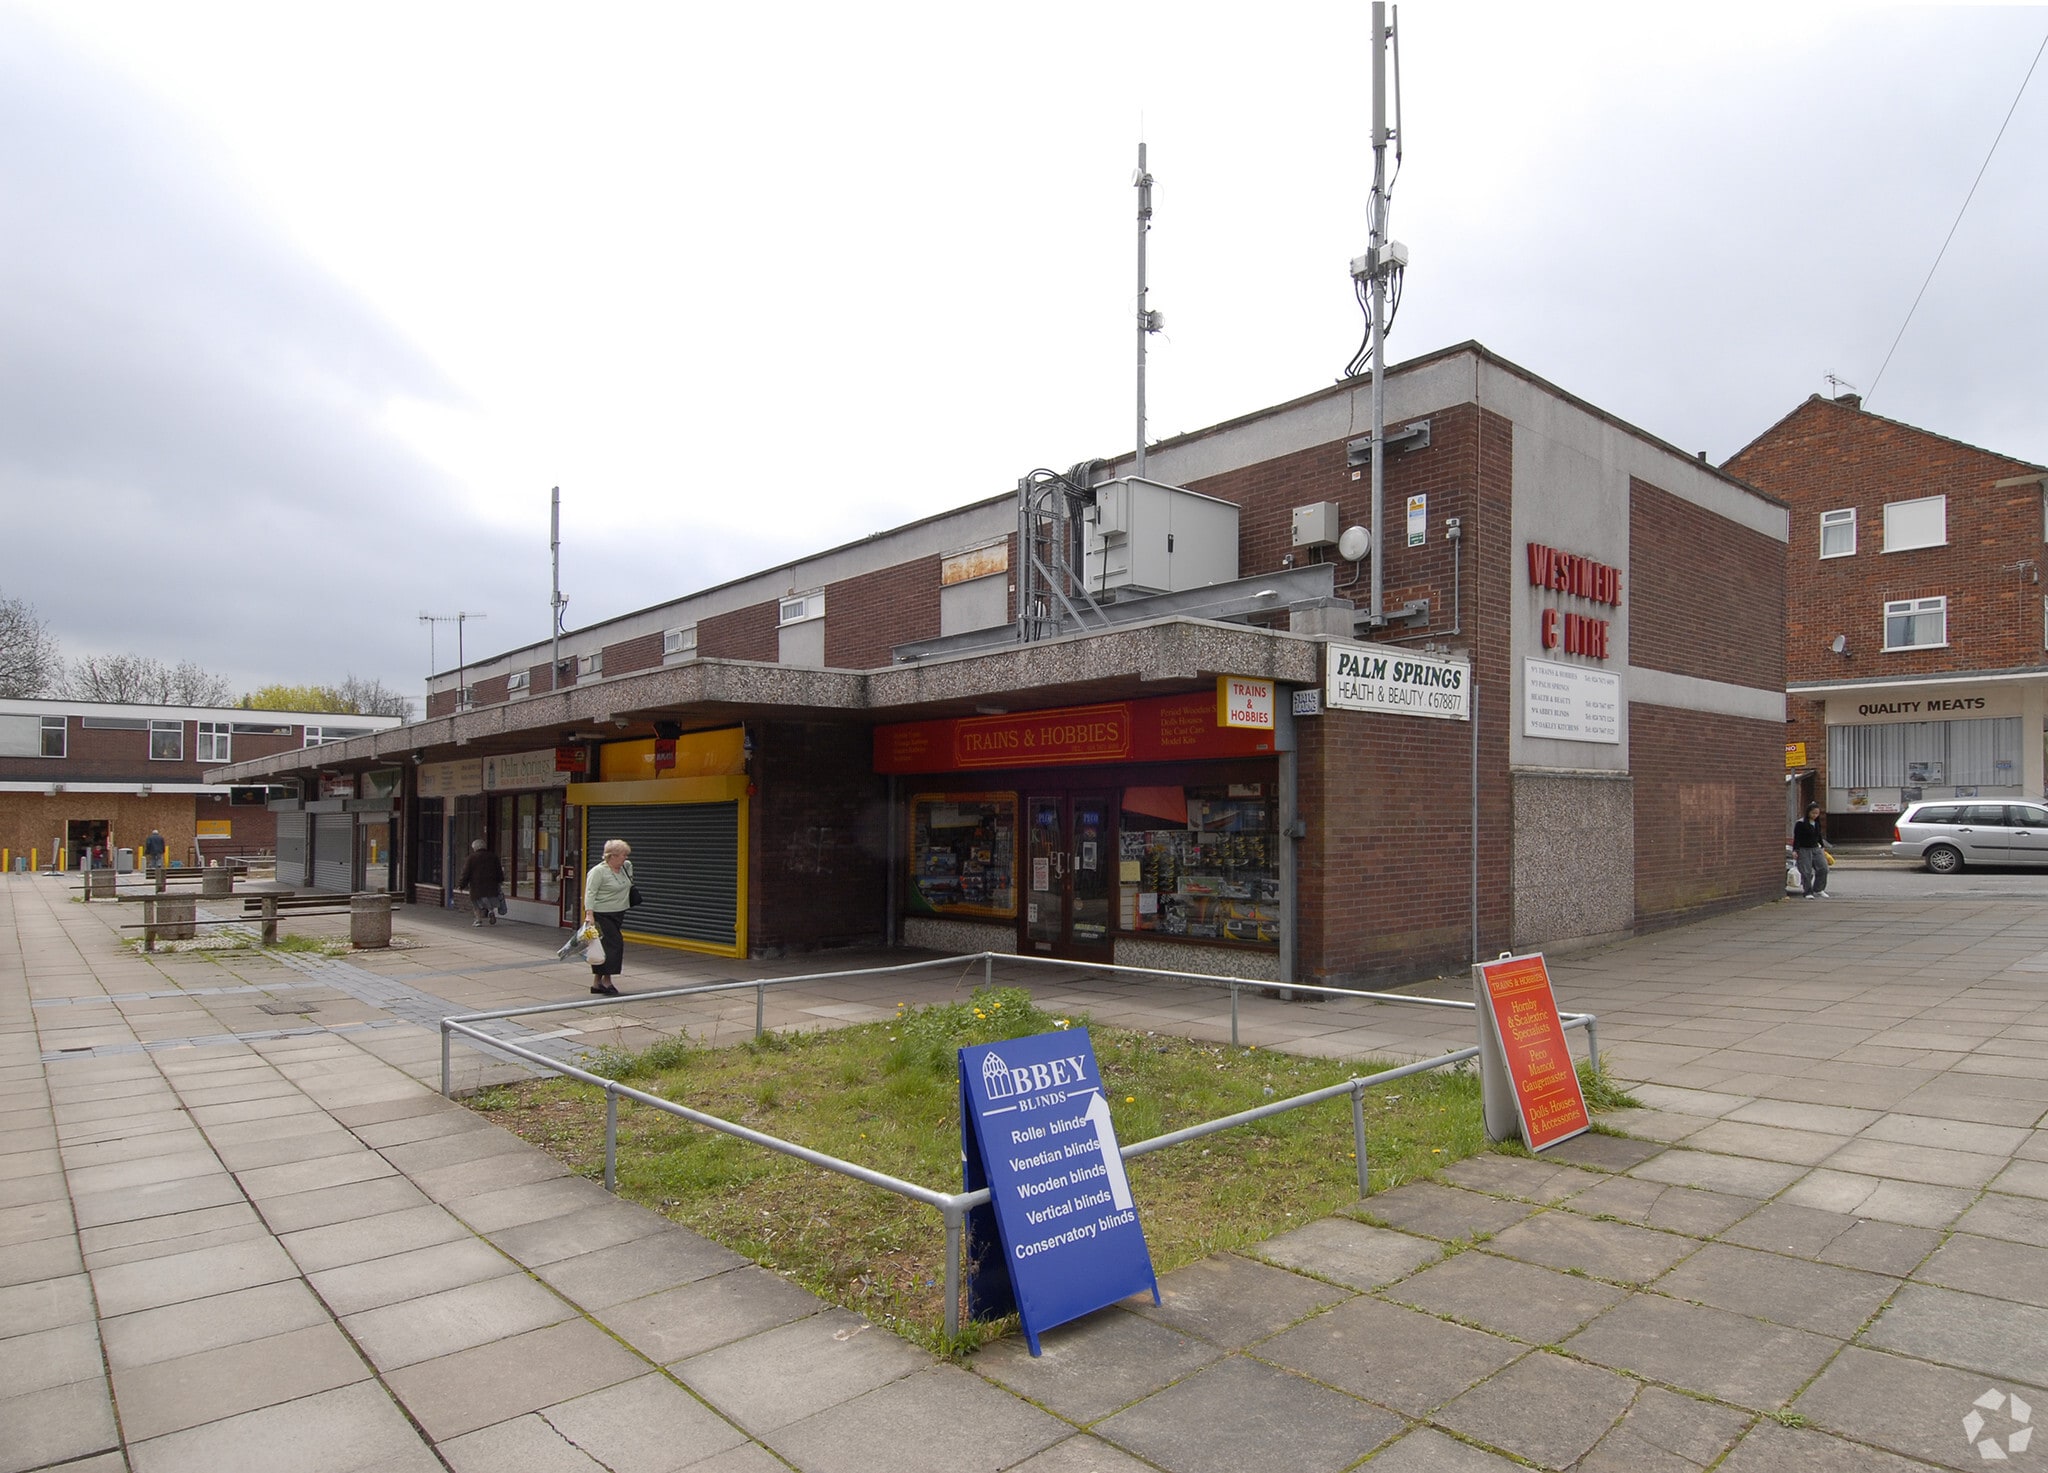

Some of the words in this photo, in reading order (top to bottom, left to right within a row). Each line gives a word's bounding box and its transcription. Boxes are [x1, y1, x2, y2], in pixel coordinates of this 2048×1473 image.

[1527, 542, 1624, 607] WESTMEDE
[1337, 653, 1388, 681] PALM
[1392, 661, 1462, 690] SPRINGS
[1233, 683, 1267, 698] TRAINS
[1338, 681, 1375, 700] HEALTH
[1377, 685, 1385, 702] &
[1388, 687, 1424, 706] BEAUTY
[1246, 699, 1253, 710] &
[1858, 701, 1921, 716] QUALITY
[1927, 698, 1985, 711] MEATS
[1231, 709, 1269, 724] HOBBIES
[964, 729, 1019, 751] TRAINS
[1023, 728, 1036, 748] &
[1040, 722, 1119, 746] HOBBIES
[1492, 979, 1514, 992] TRAINS
[1511, 999, 1537, 1013] Hornby
[1507, 1016, 1515, 1028] &
[1514, 1010, 1549, 1027] Scalextric
[1512, 1023, 1551, 1041] Specialists
[1529, 1049, 1547, 1062] Peco
[1528, 1058, 1555, 1076] Mamod
[1522, 1070, 1567, 1093] Gaugemaster
[1018, 1091, 1067, 1112] BLINDS
[1529, 1104, 1550, 1121] Dolls
[1549, 1097, 1576, 1113] Houses
[1049, 1115, 1087, 1135] blinds
[1532, 1121, 1540, 1135] &
[1541, 1109, 1580, 1131] Accessories
[1009, 1149, 1062, 1172] Venetian
[1064, 1138, 1101, 1158] blinds
[1017, 1176, 1068, 1199] Wooden
[1069, 1163, 1107, 1184] blinds
[1026, 1199, 1073, 1225] Vertical
[1074, 1190, 1111, 1211] blinds
[1015, 1222, 1097, 1259] Conservatory
[1098, 1210, 1135, 1231] blinds
